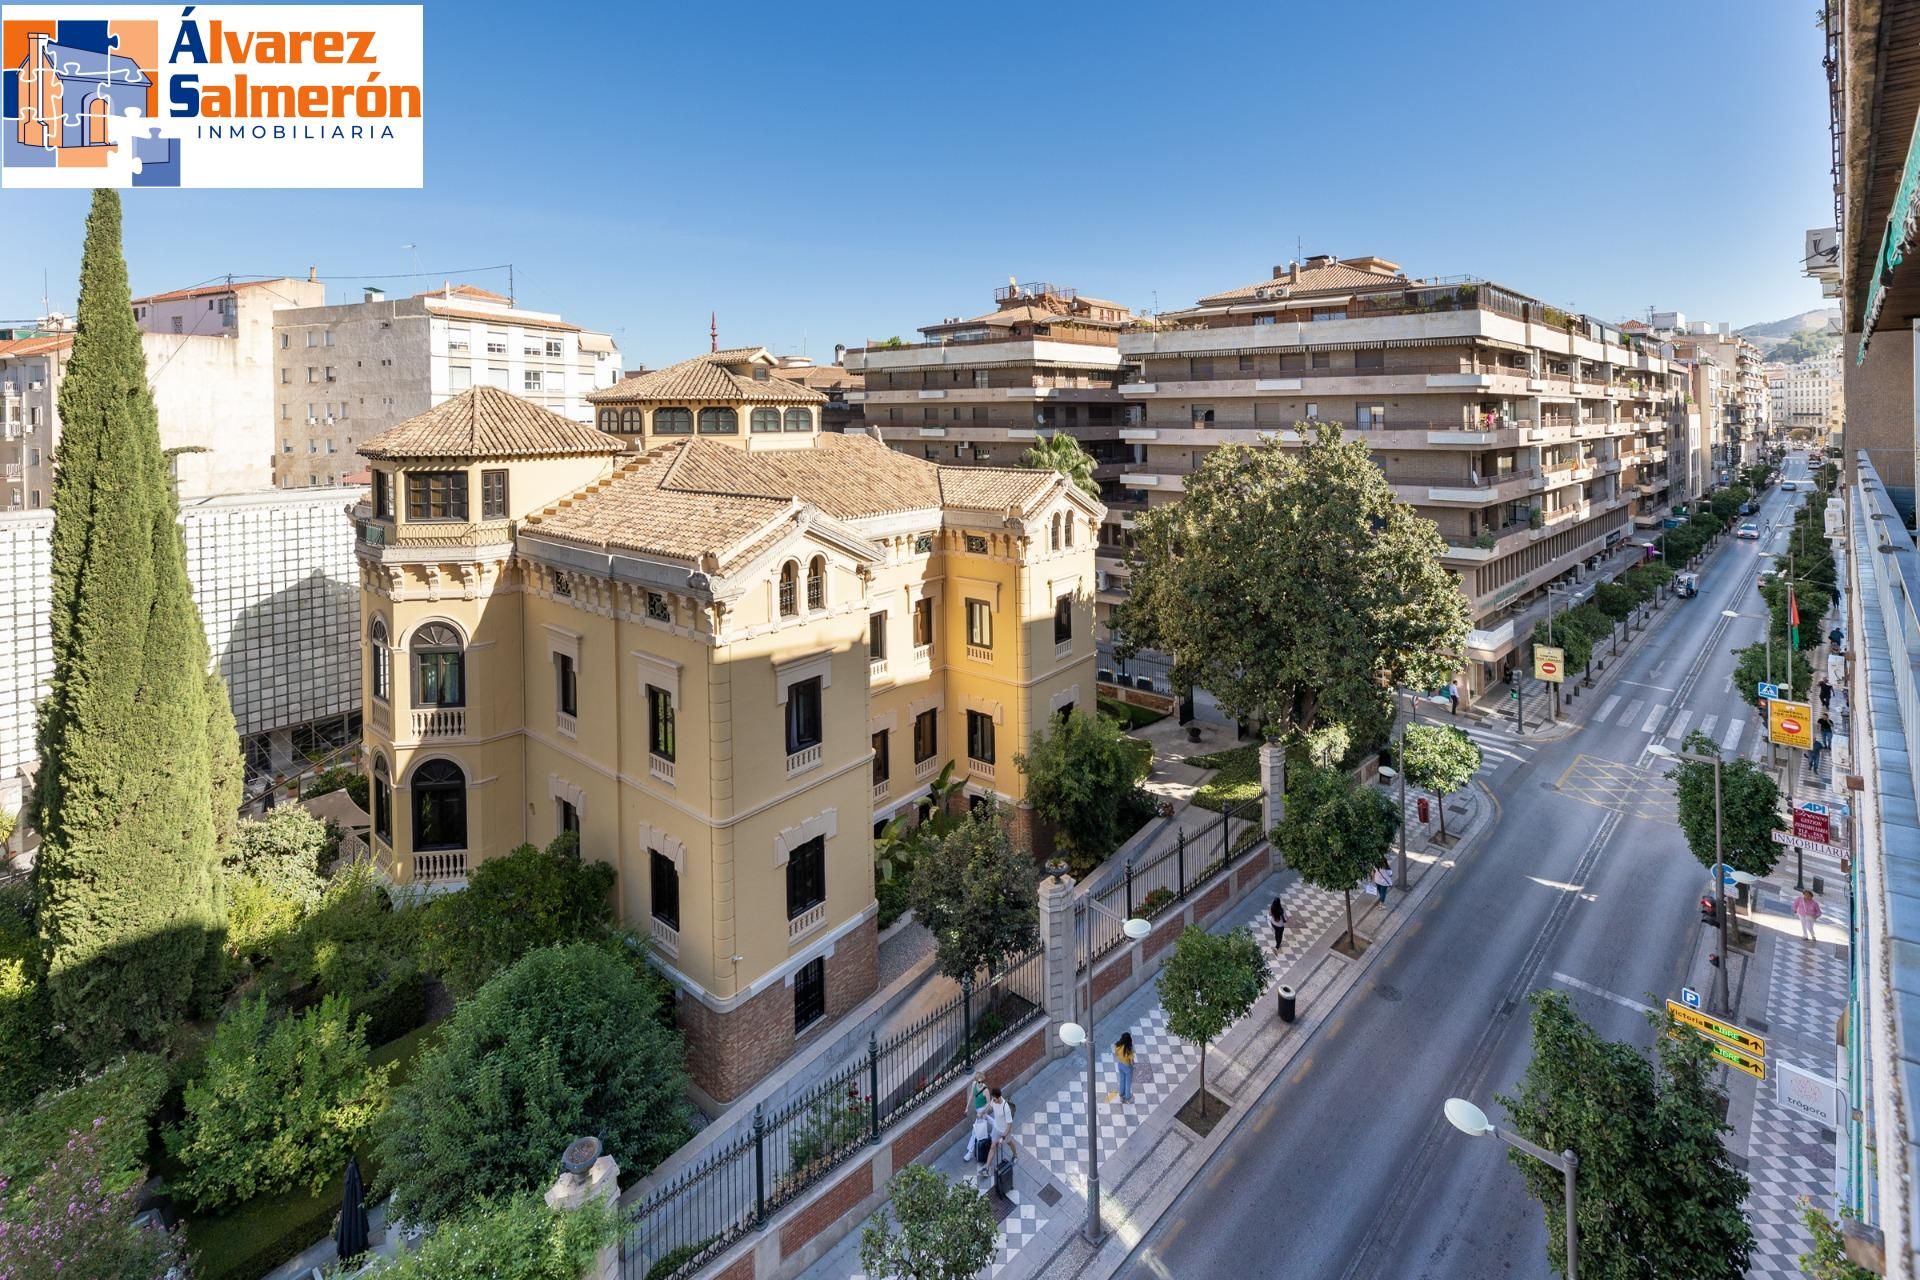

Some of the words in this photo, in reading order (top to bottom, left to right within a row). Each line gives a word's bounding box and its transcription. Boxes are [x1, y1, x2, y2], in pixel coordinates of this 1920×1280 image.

[1801, 802, 1826, 815] API
[1774, 832, 1850, 859] INMOBILIARIA
[1686, 992, 1696, 1002] P
[1669, 1007, 1703, 1026] Victoria
[1712, 1024, 1740, 1041] LIBRE
[1712, 1046, 1740, 1063] LIBRE
